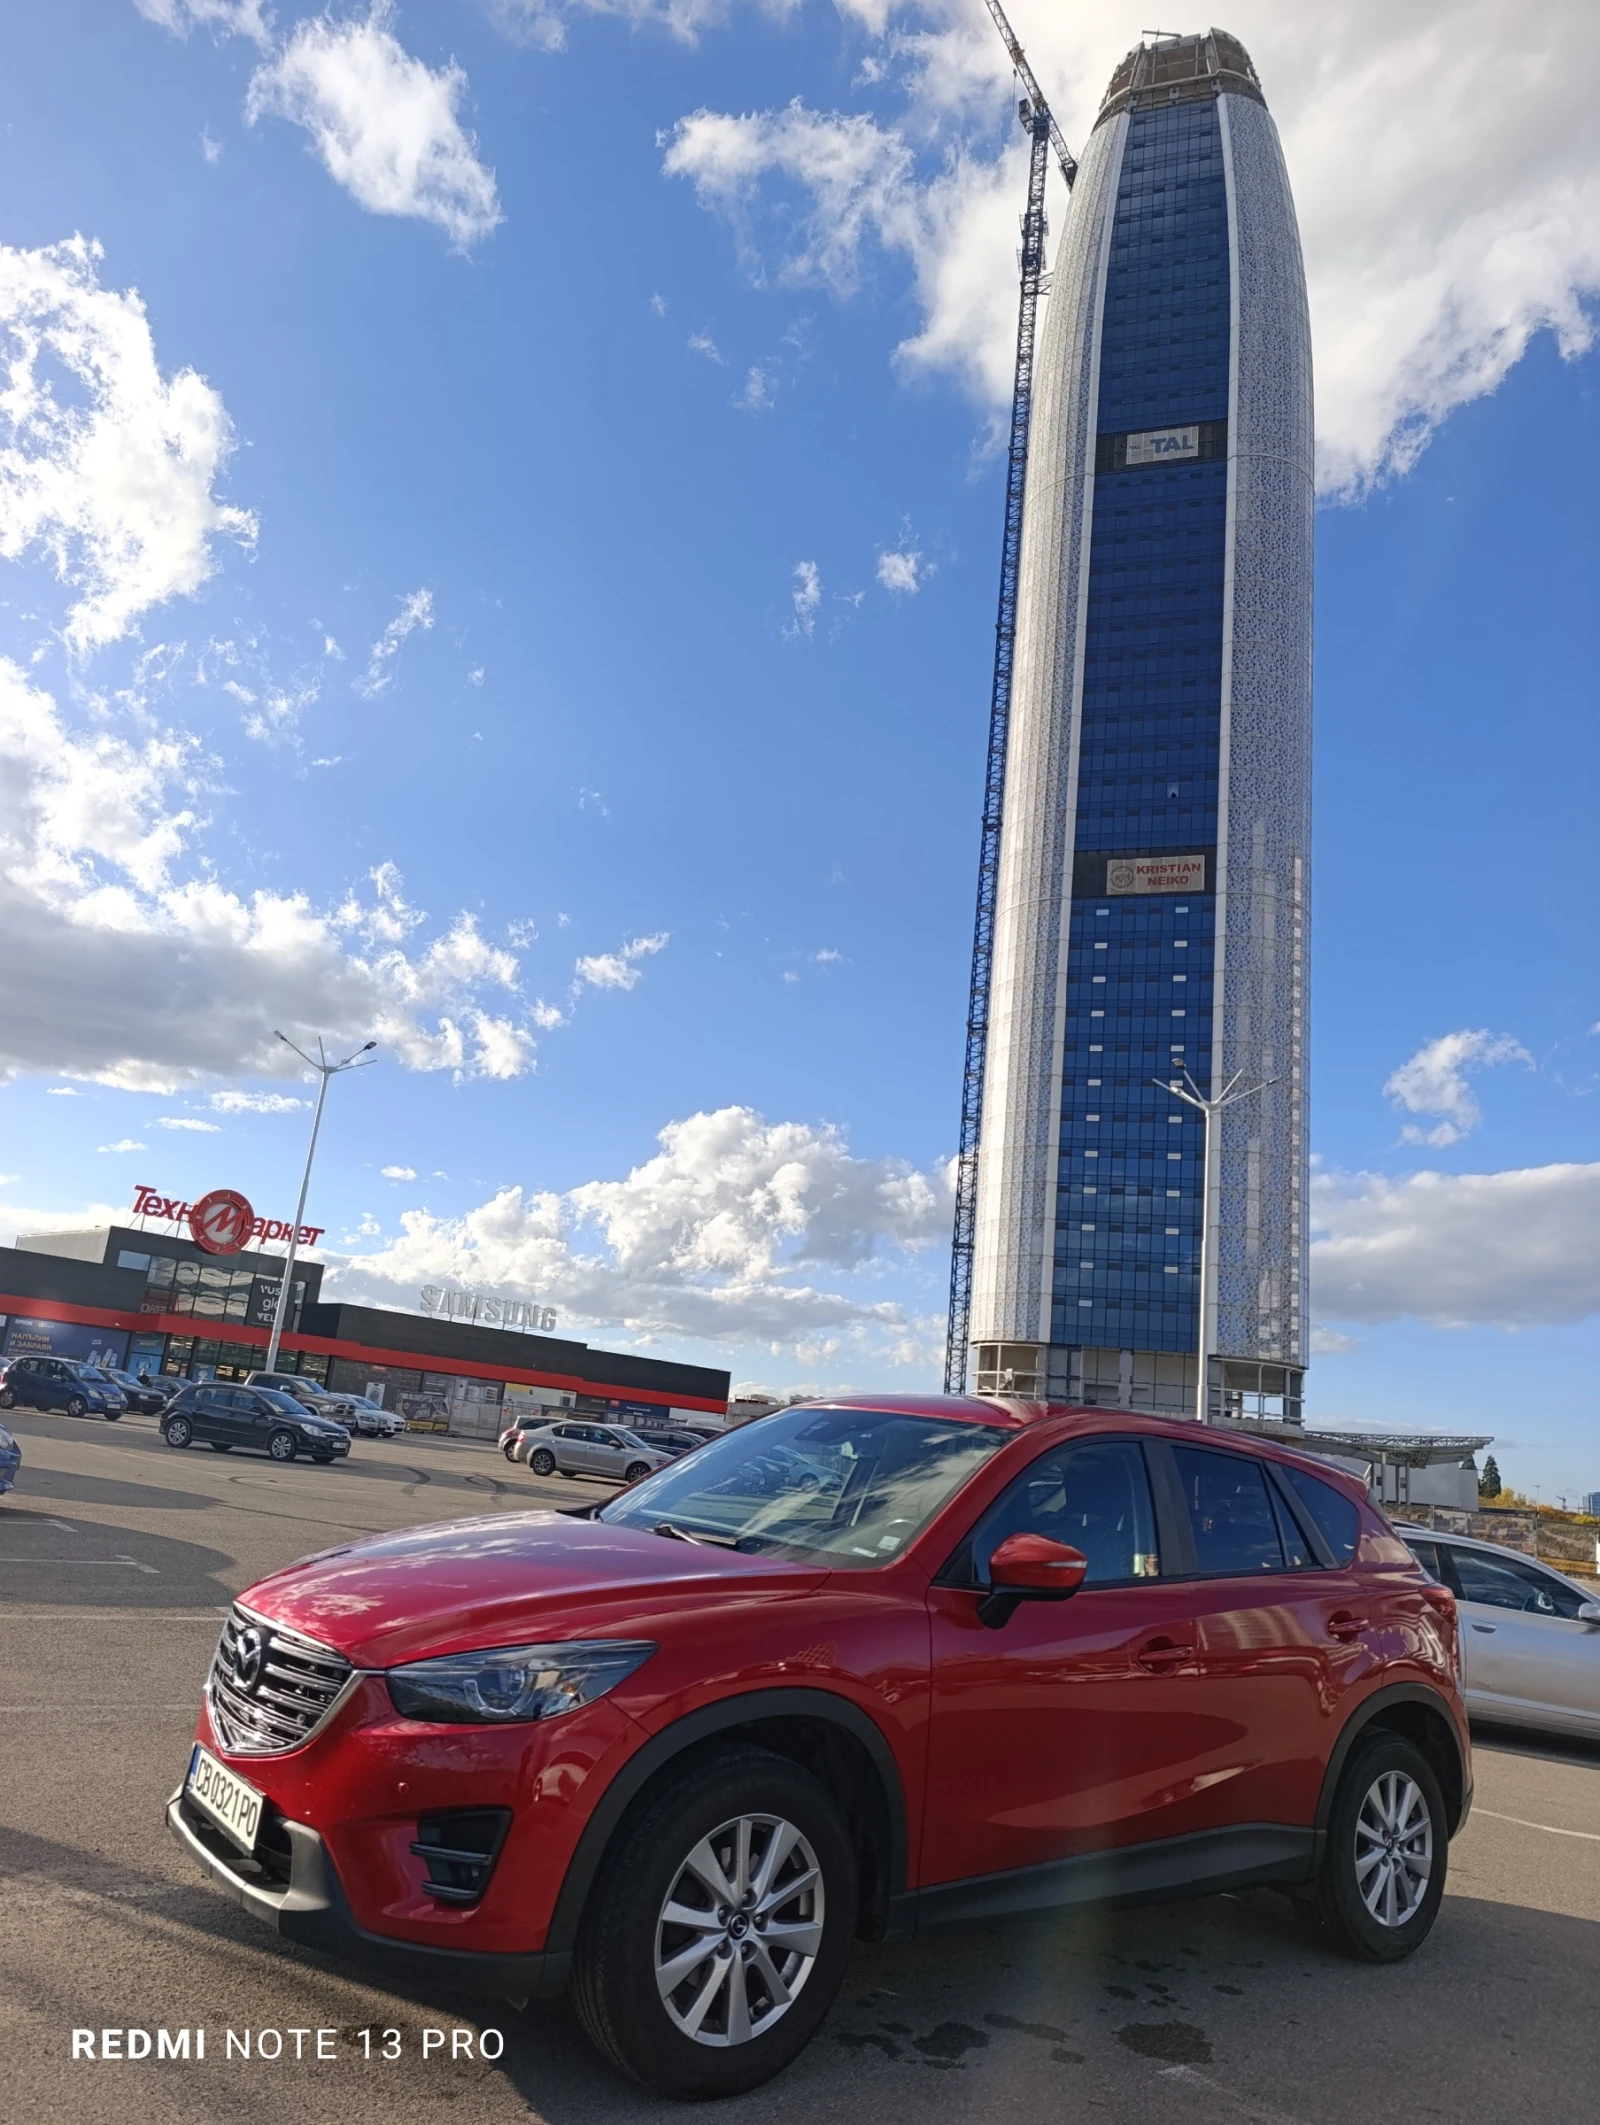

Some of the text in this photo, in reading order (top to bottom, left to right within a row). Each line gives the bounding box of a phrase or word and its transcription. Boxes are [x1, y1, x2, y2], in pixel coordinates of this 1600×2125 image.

[1150, 435, 1194, 453] TAL
[1136, 863, 1201, 875] KRISTIAN
[1148, 876, 1189, 886] NEIKO
[260, 1285, 282, 1296] VUS
[420, 1284, 557, 1332] SAMSUNG
[257, 1312, 276, 1322] VEL
